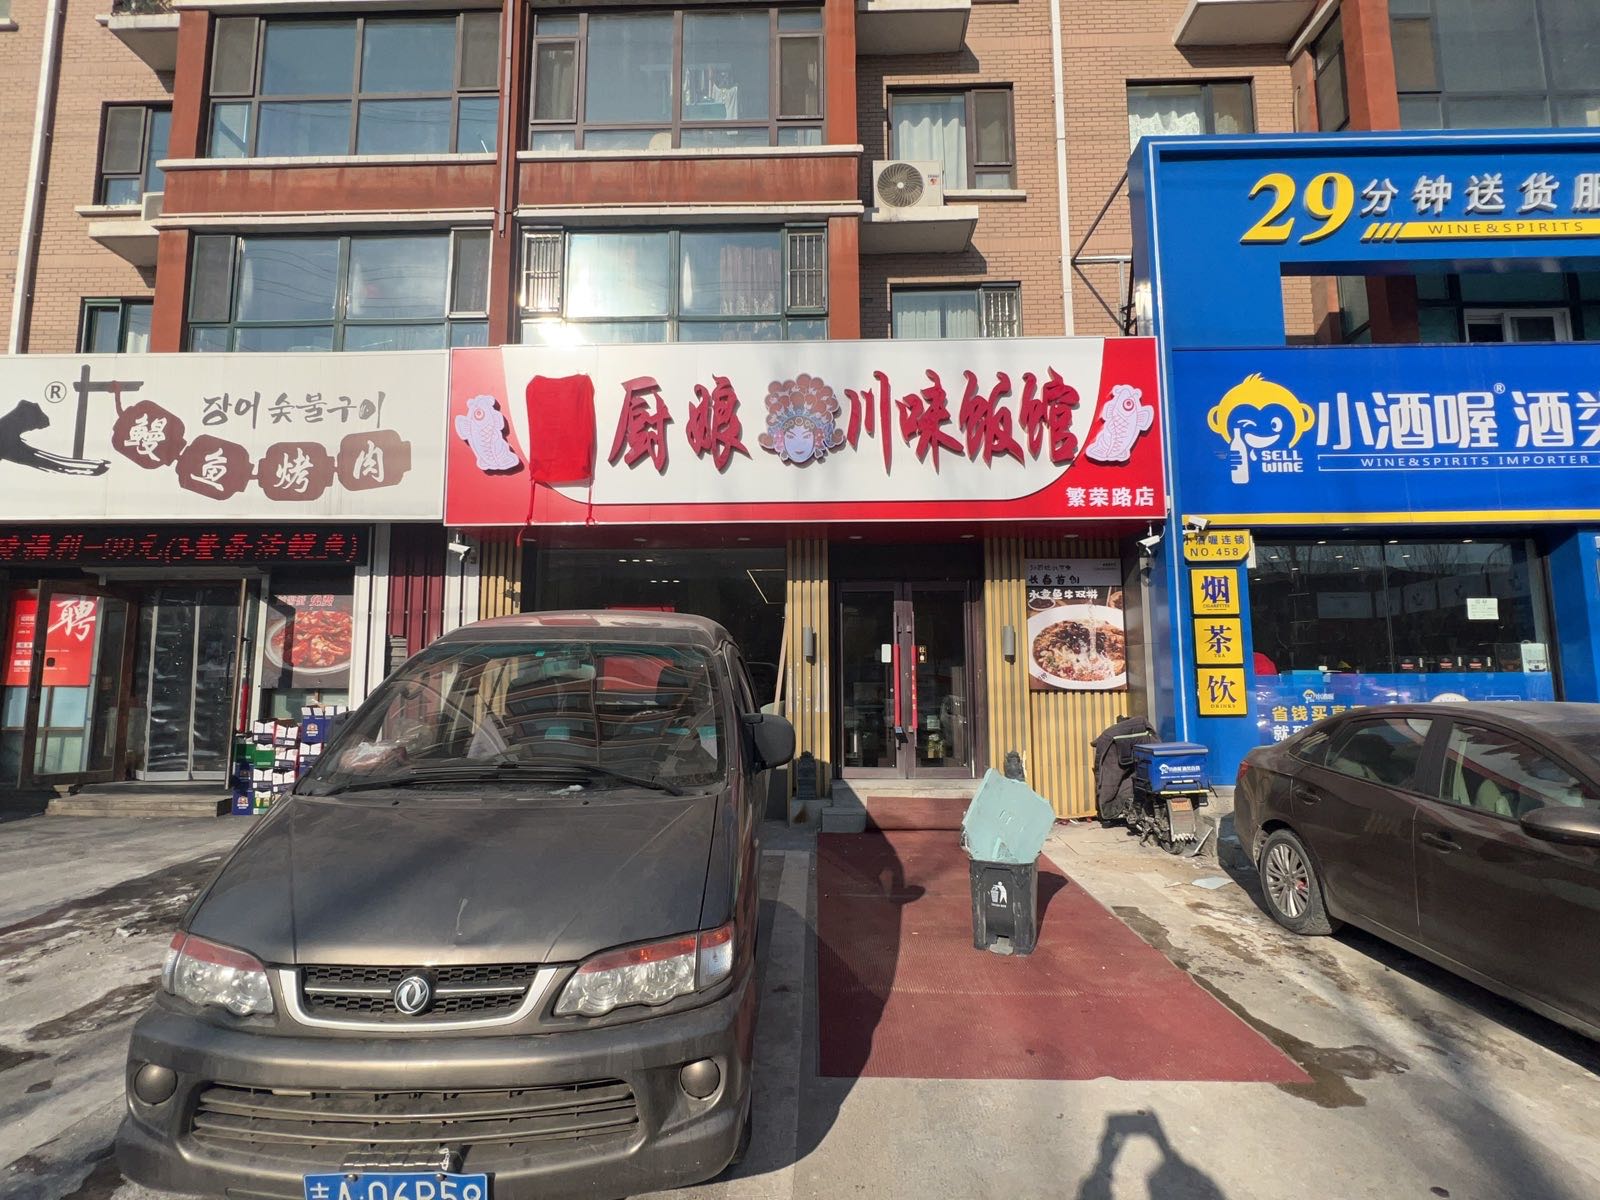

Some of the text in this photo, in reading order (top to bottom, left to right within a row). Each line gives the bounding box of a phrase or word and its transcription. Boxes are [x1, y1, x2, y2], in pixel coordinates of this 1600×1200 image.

[1428, 221, 1583, 235] WINE&SPIRITS
[202, 391, 261, 429] 장어
[608, 366, 1080, 475] 厨娘 川味饭馆
[1261, 450, 1303, 461] SELL
[1361, 455, 1590, 468] WINE&SPIRITS IMPORTER
[1065, 487, 1154, 508] 繁荣路店
[1201, 575, 1231, 604] 烟
[47, 600, 96, 641] 聘
[1204, 625, 1233, 654] 茶
[1207, 675, 1237, 703] 饮
[1272, 705, 1366, 722] 省钱买真
